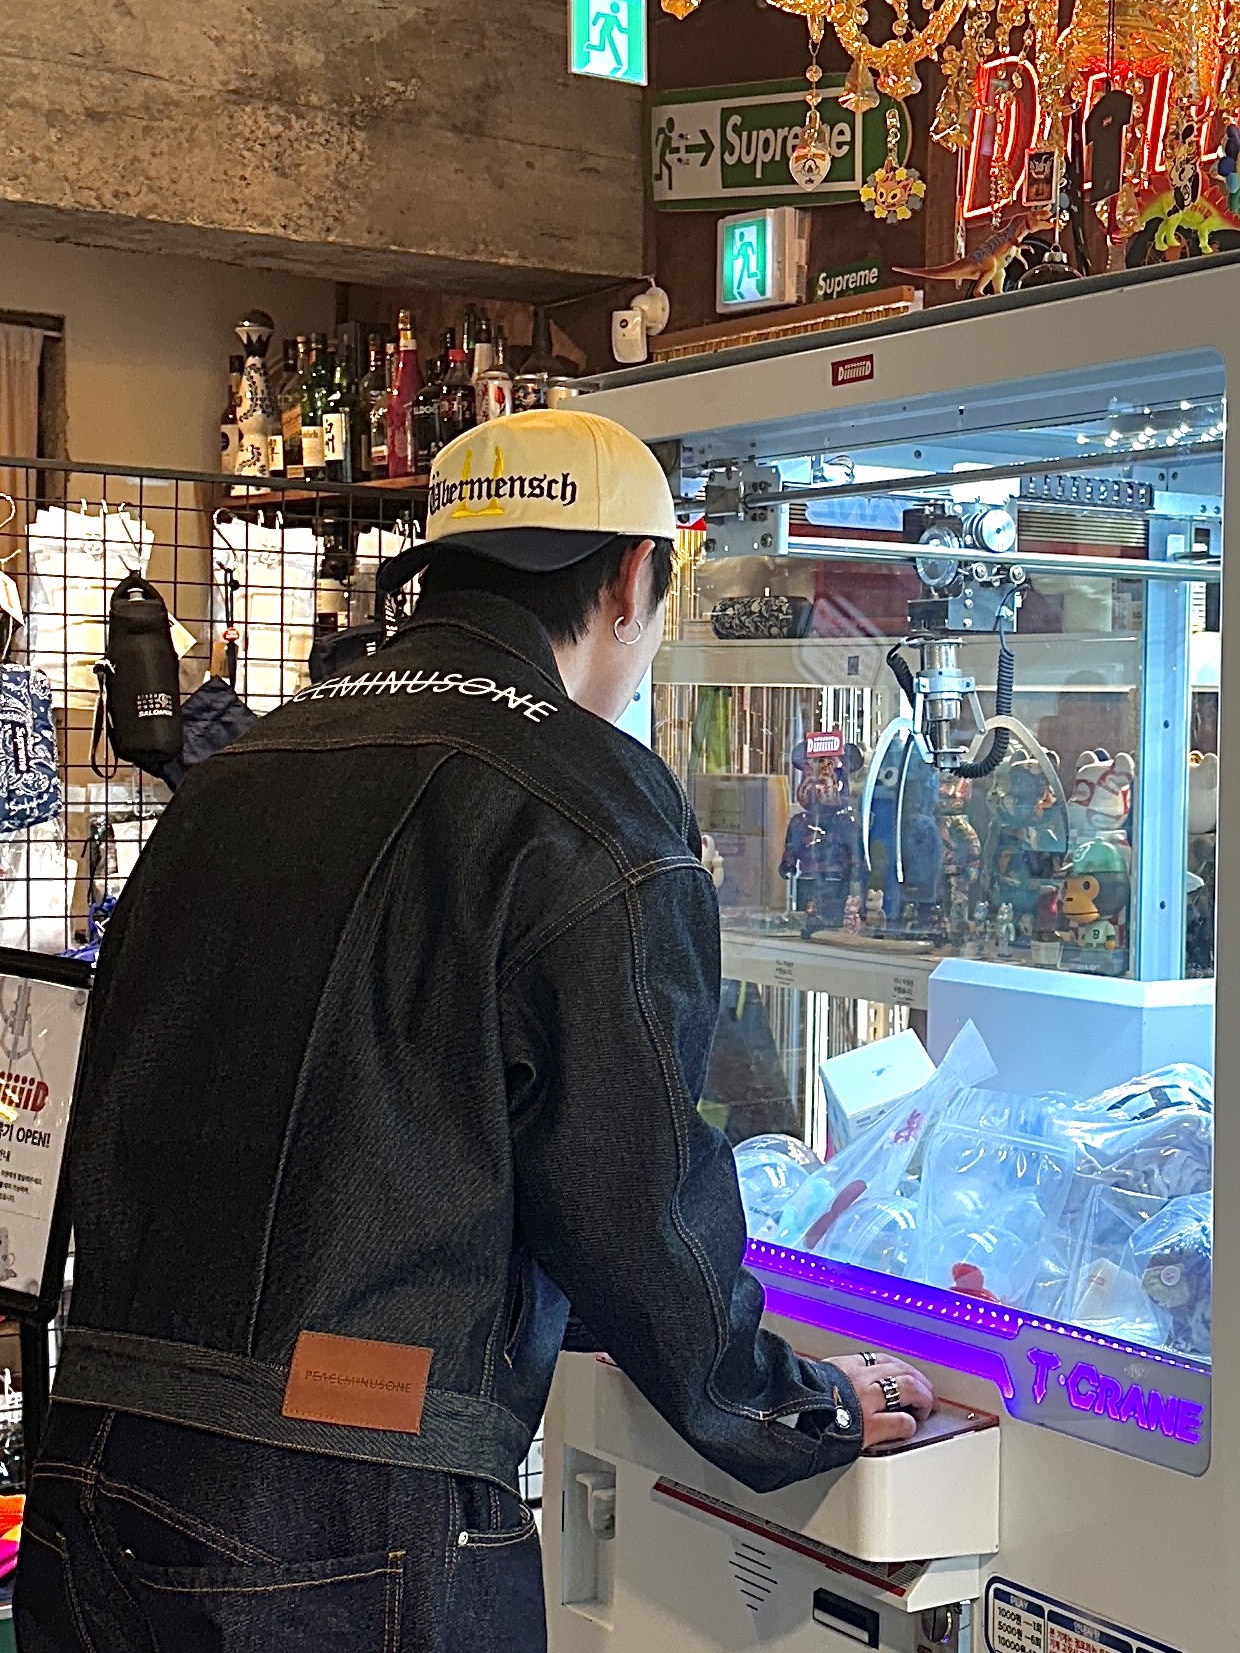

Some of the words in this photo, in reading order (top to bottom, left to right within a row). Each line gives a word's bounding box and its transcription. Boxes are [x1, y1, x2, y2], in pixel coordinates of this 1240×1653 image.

[817, 267, 879, 299] Supreme
[428, 471, 578, 516] Übermensch
[16, 1126, 51, 1149] OPEN!
[1010, 1594, 1029, 1610] PLAY
